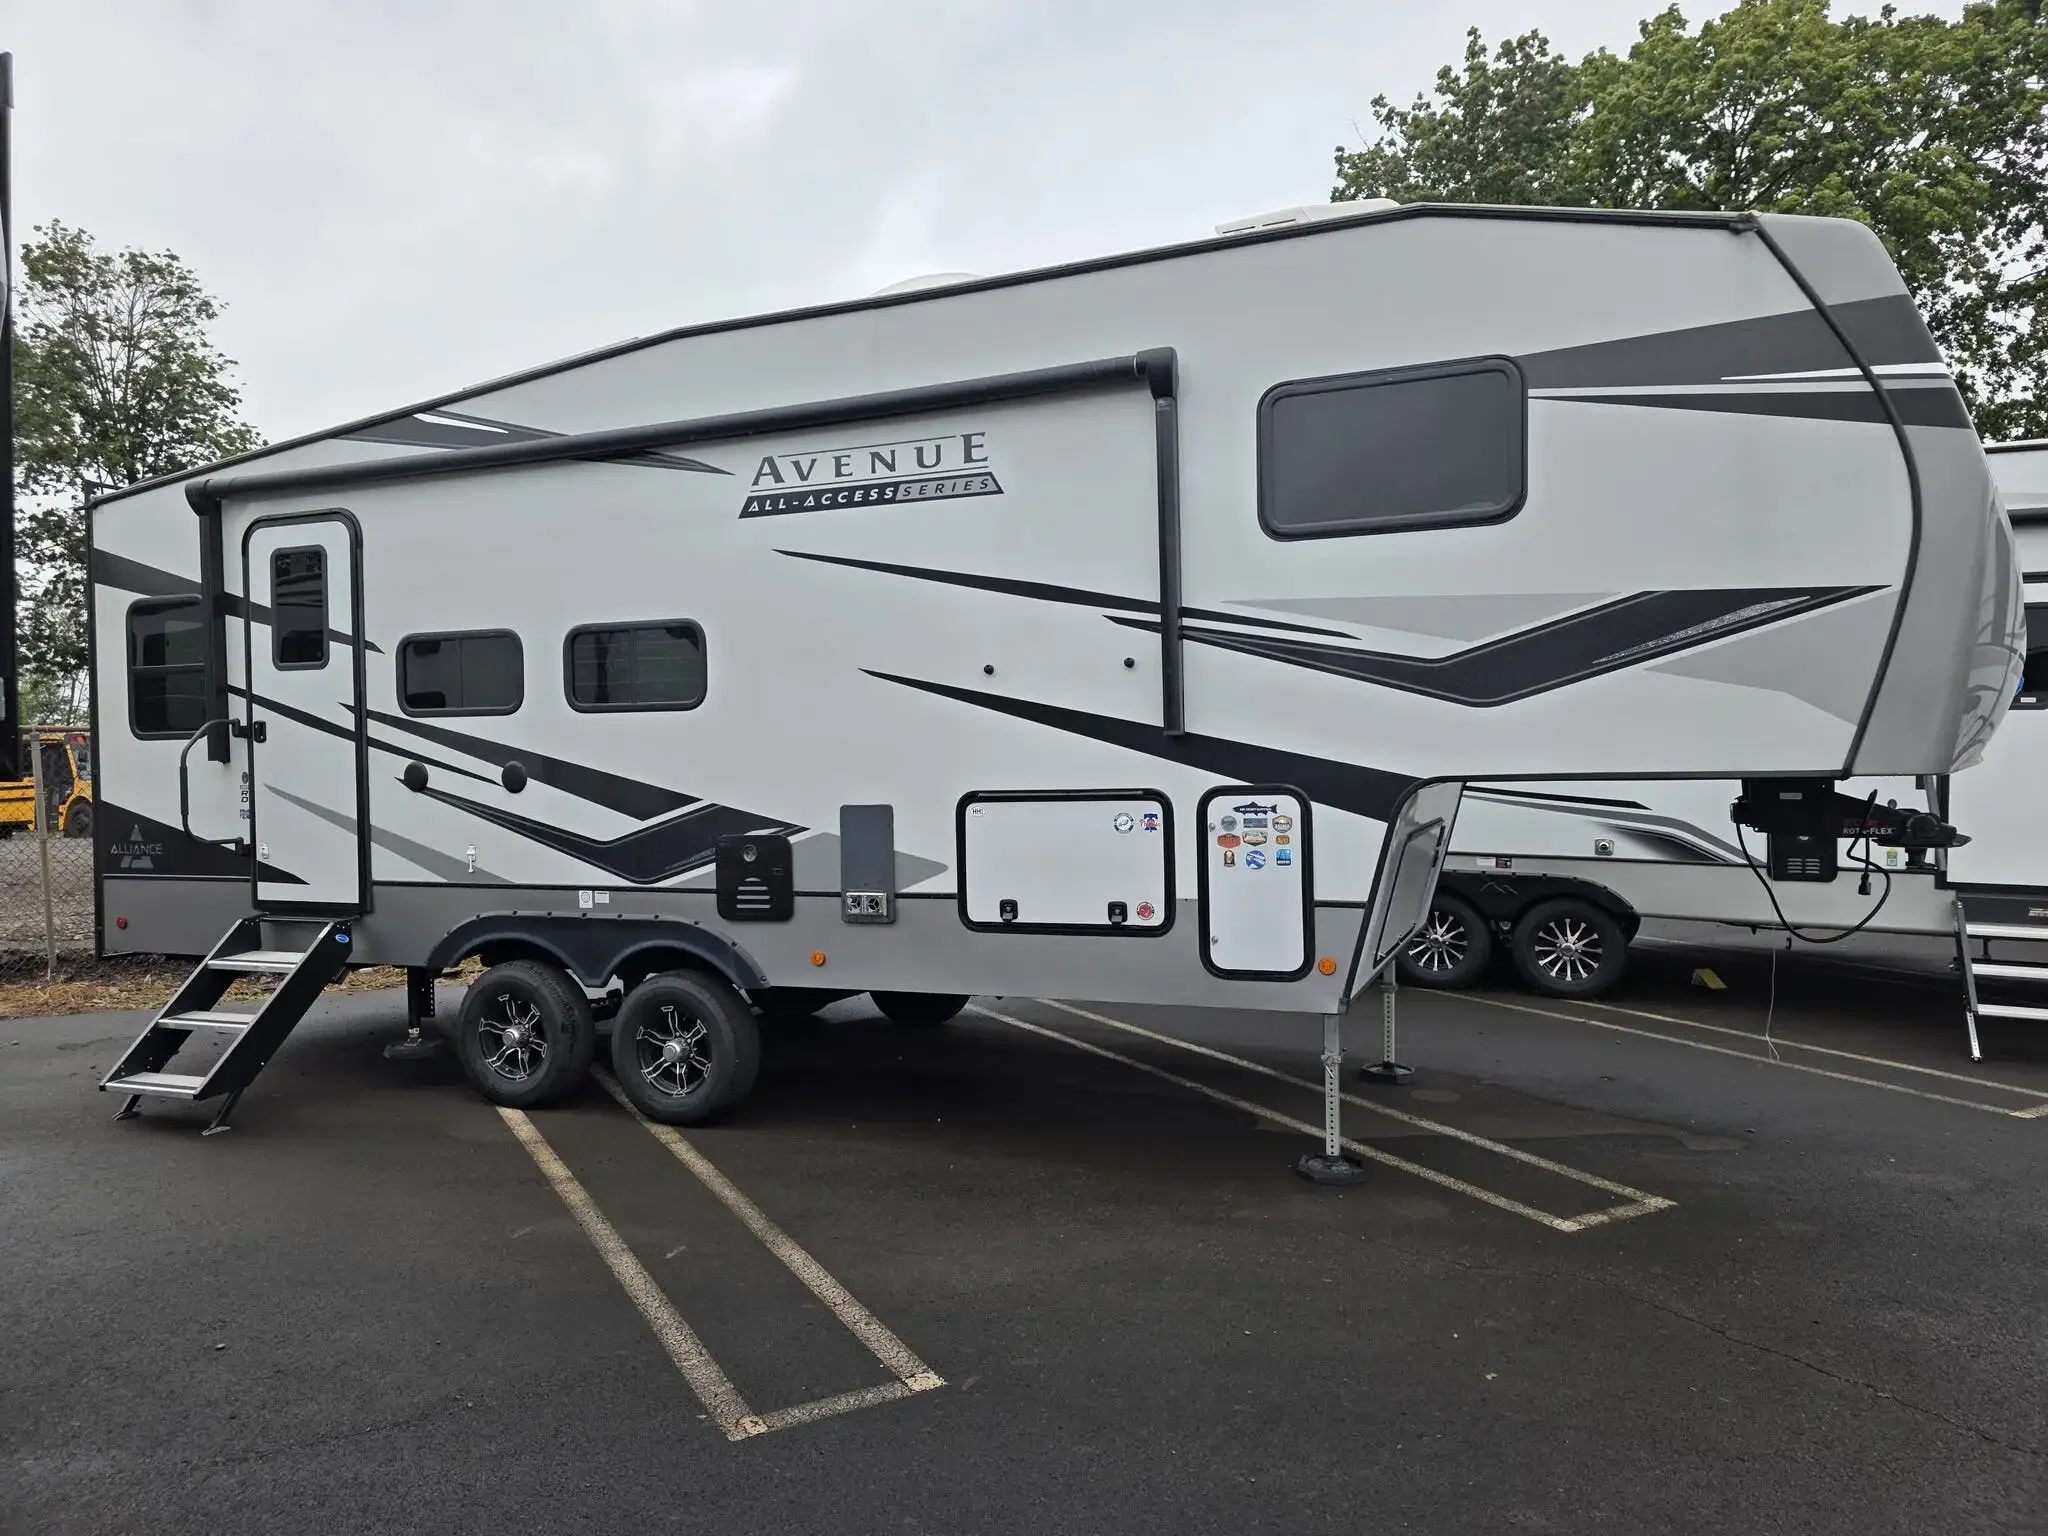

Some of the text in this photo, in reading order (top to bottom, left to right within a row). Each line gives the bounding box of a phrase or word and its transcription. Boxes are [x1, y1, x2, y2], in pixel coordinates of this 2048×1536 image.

[751, 431, 989, 487] AVENUE
[747, 478, 990, 512] ALL-ACCESS SERIES
[110, 843, 163, 855] ALLIANCE
